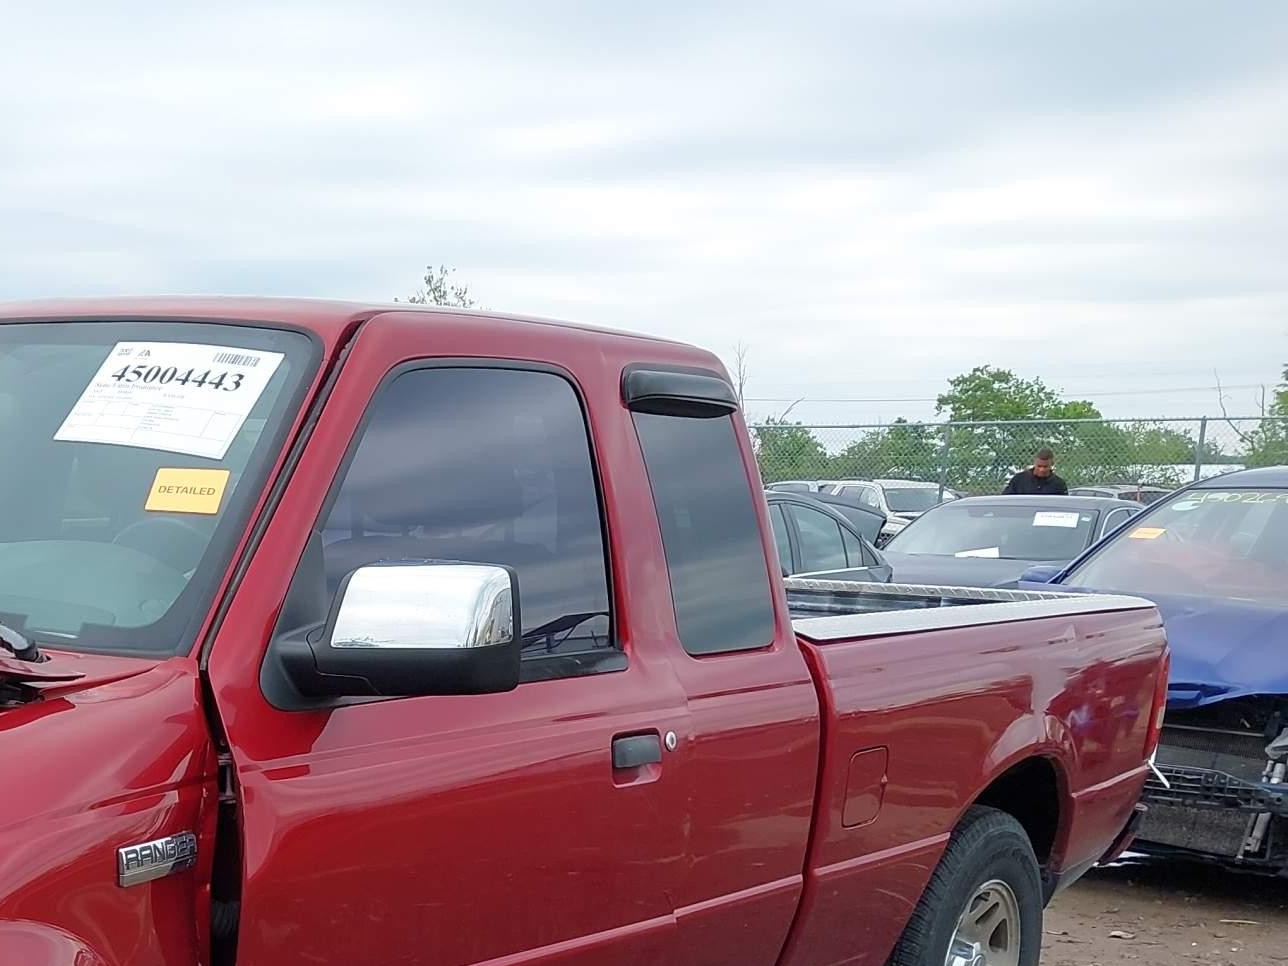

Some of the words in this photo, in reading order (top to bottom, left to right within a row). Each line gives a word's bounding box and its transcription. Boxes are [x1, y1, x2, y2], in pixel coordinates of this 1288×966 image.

[112, 364, 245, 392] 45004443
[158, 485, 216, 496] DETAILED
[124, 836, 196, 870] RANGER
